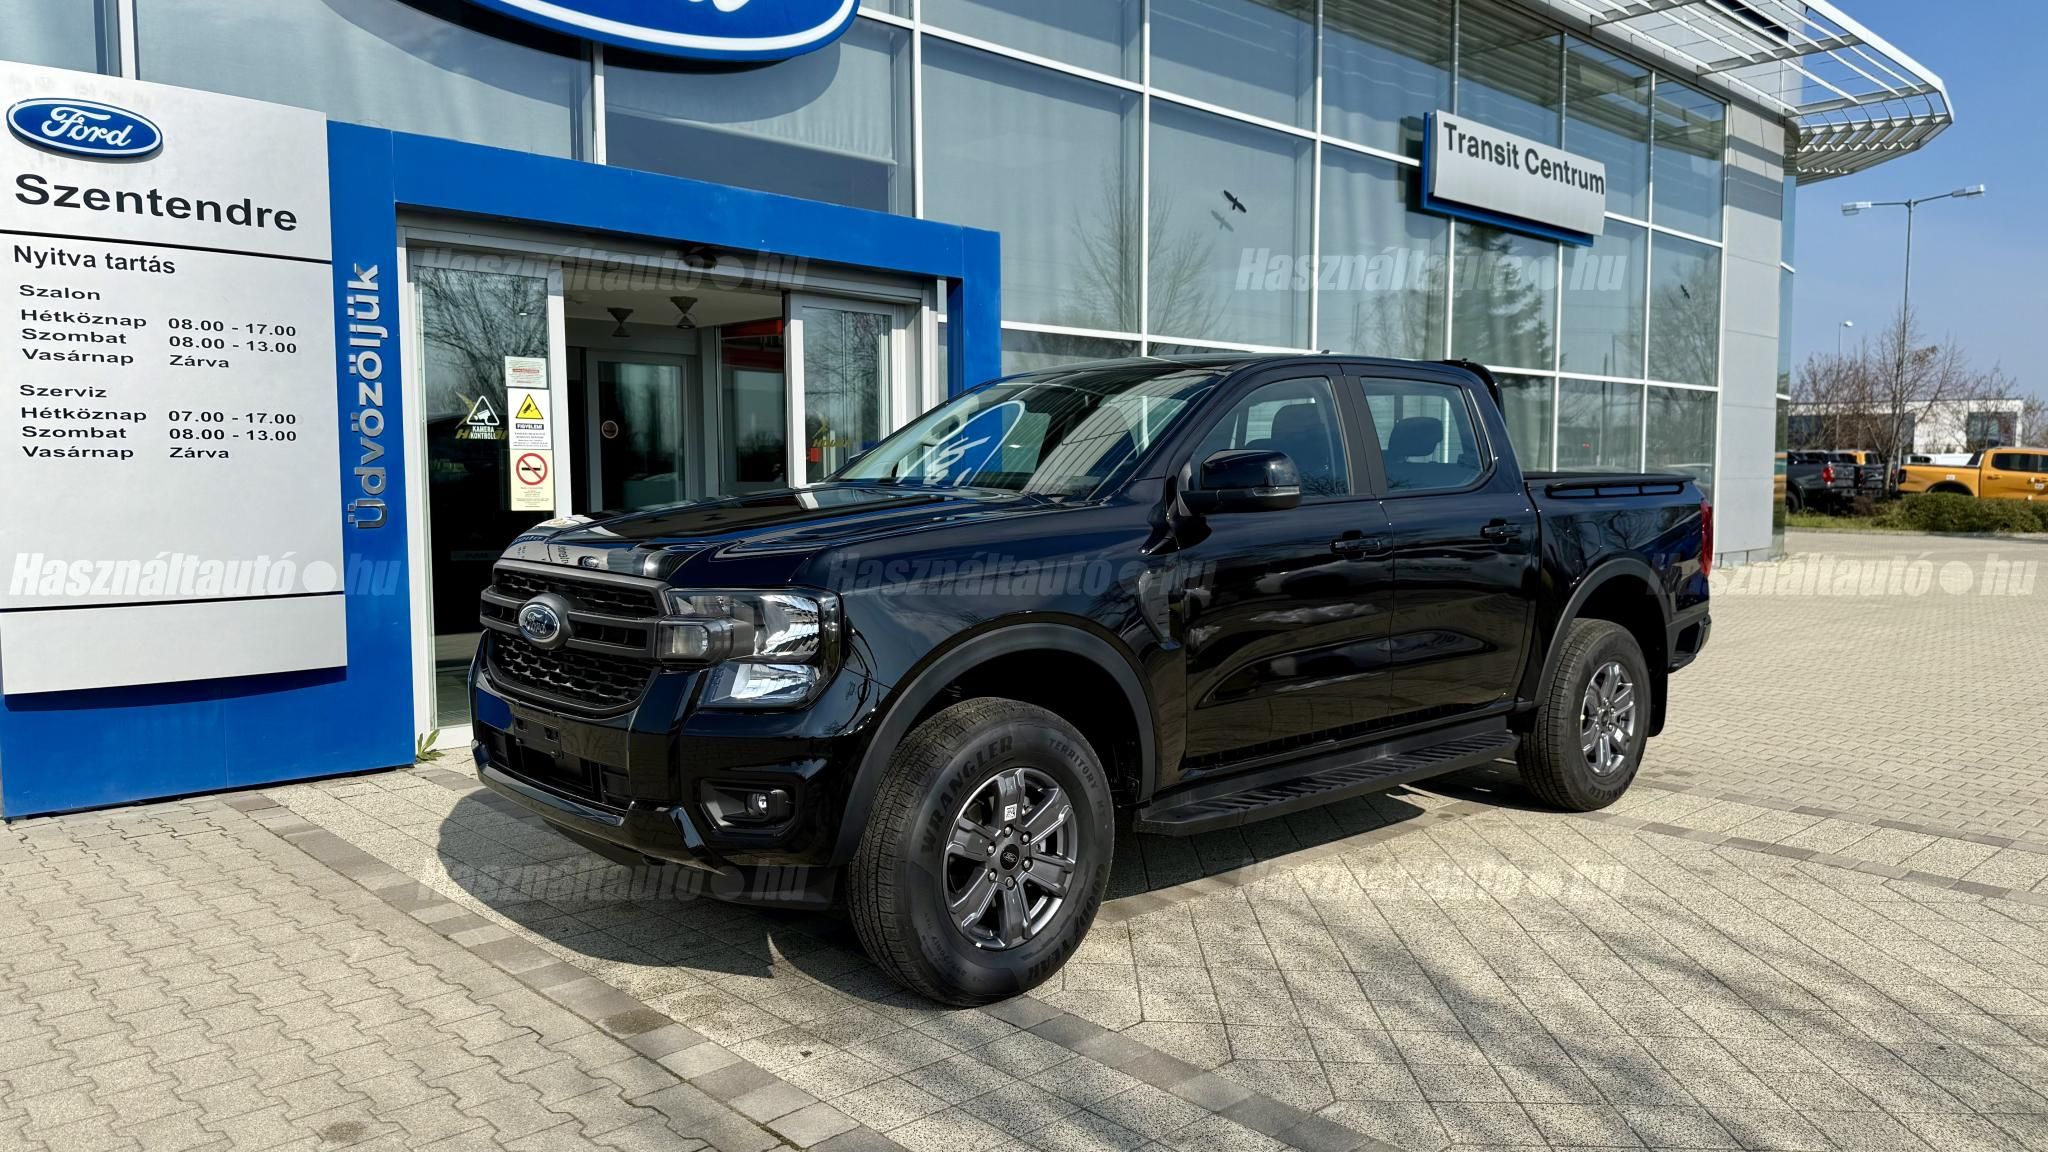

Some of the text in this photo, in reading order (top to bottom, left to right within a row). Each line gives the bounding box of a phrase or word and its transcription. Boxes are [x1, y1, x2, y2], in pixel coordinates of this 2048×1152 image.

[40, 105, 133, 148] Ford
[1443, 121, 1605, 195] Transit Centrum
[14, 173, 298, 232] Szentendre
[13, 244, 177, 274] Nyitva tartás
[19, 284, 101, 301] Szalon
[20, 309, 147, 329] Hétköznap
[168, 318, 225, 332] 08.00
[245, 323, 297, 337] 17.00
[21, 328, 127, 345] Szombat
[168, 336, 225, 350] 08.00
[245, 340, 297, 354] 13.00
[21, 348, 230, 368] Vasárnap Zárva
[19, 384, 108, 399] Szerviz
[347, 262, 389, 530] Üdvözöljük
[20, 405, 147, 422] Hétköznap
[168, 410, 225, 424] 07.00
[245, 412, 297, 425] 17.00
[21, 425, 127, 439] Szombat
[168, 428, 225, 441] 08.00
[245, 429, 297, 442] 13.00
[21, 445, 230, 460] Vasárnap Zárva
[525, 610, 549, 635] Ford
[1048, 737, 1098, 789] TERRITORY
[920, 735, 1014, 854] WRANGLER
